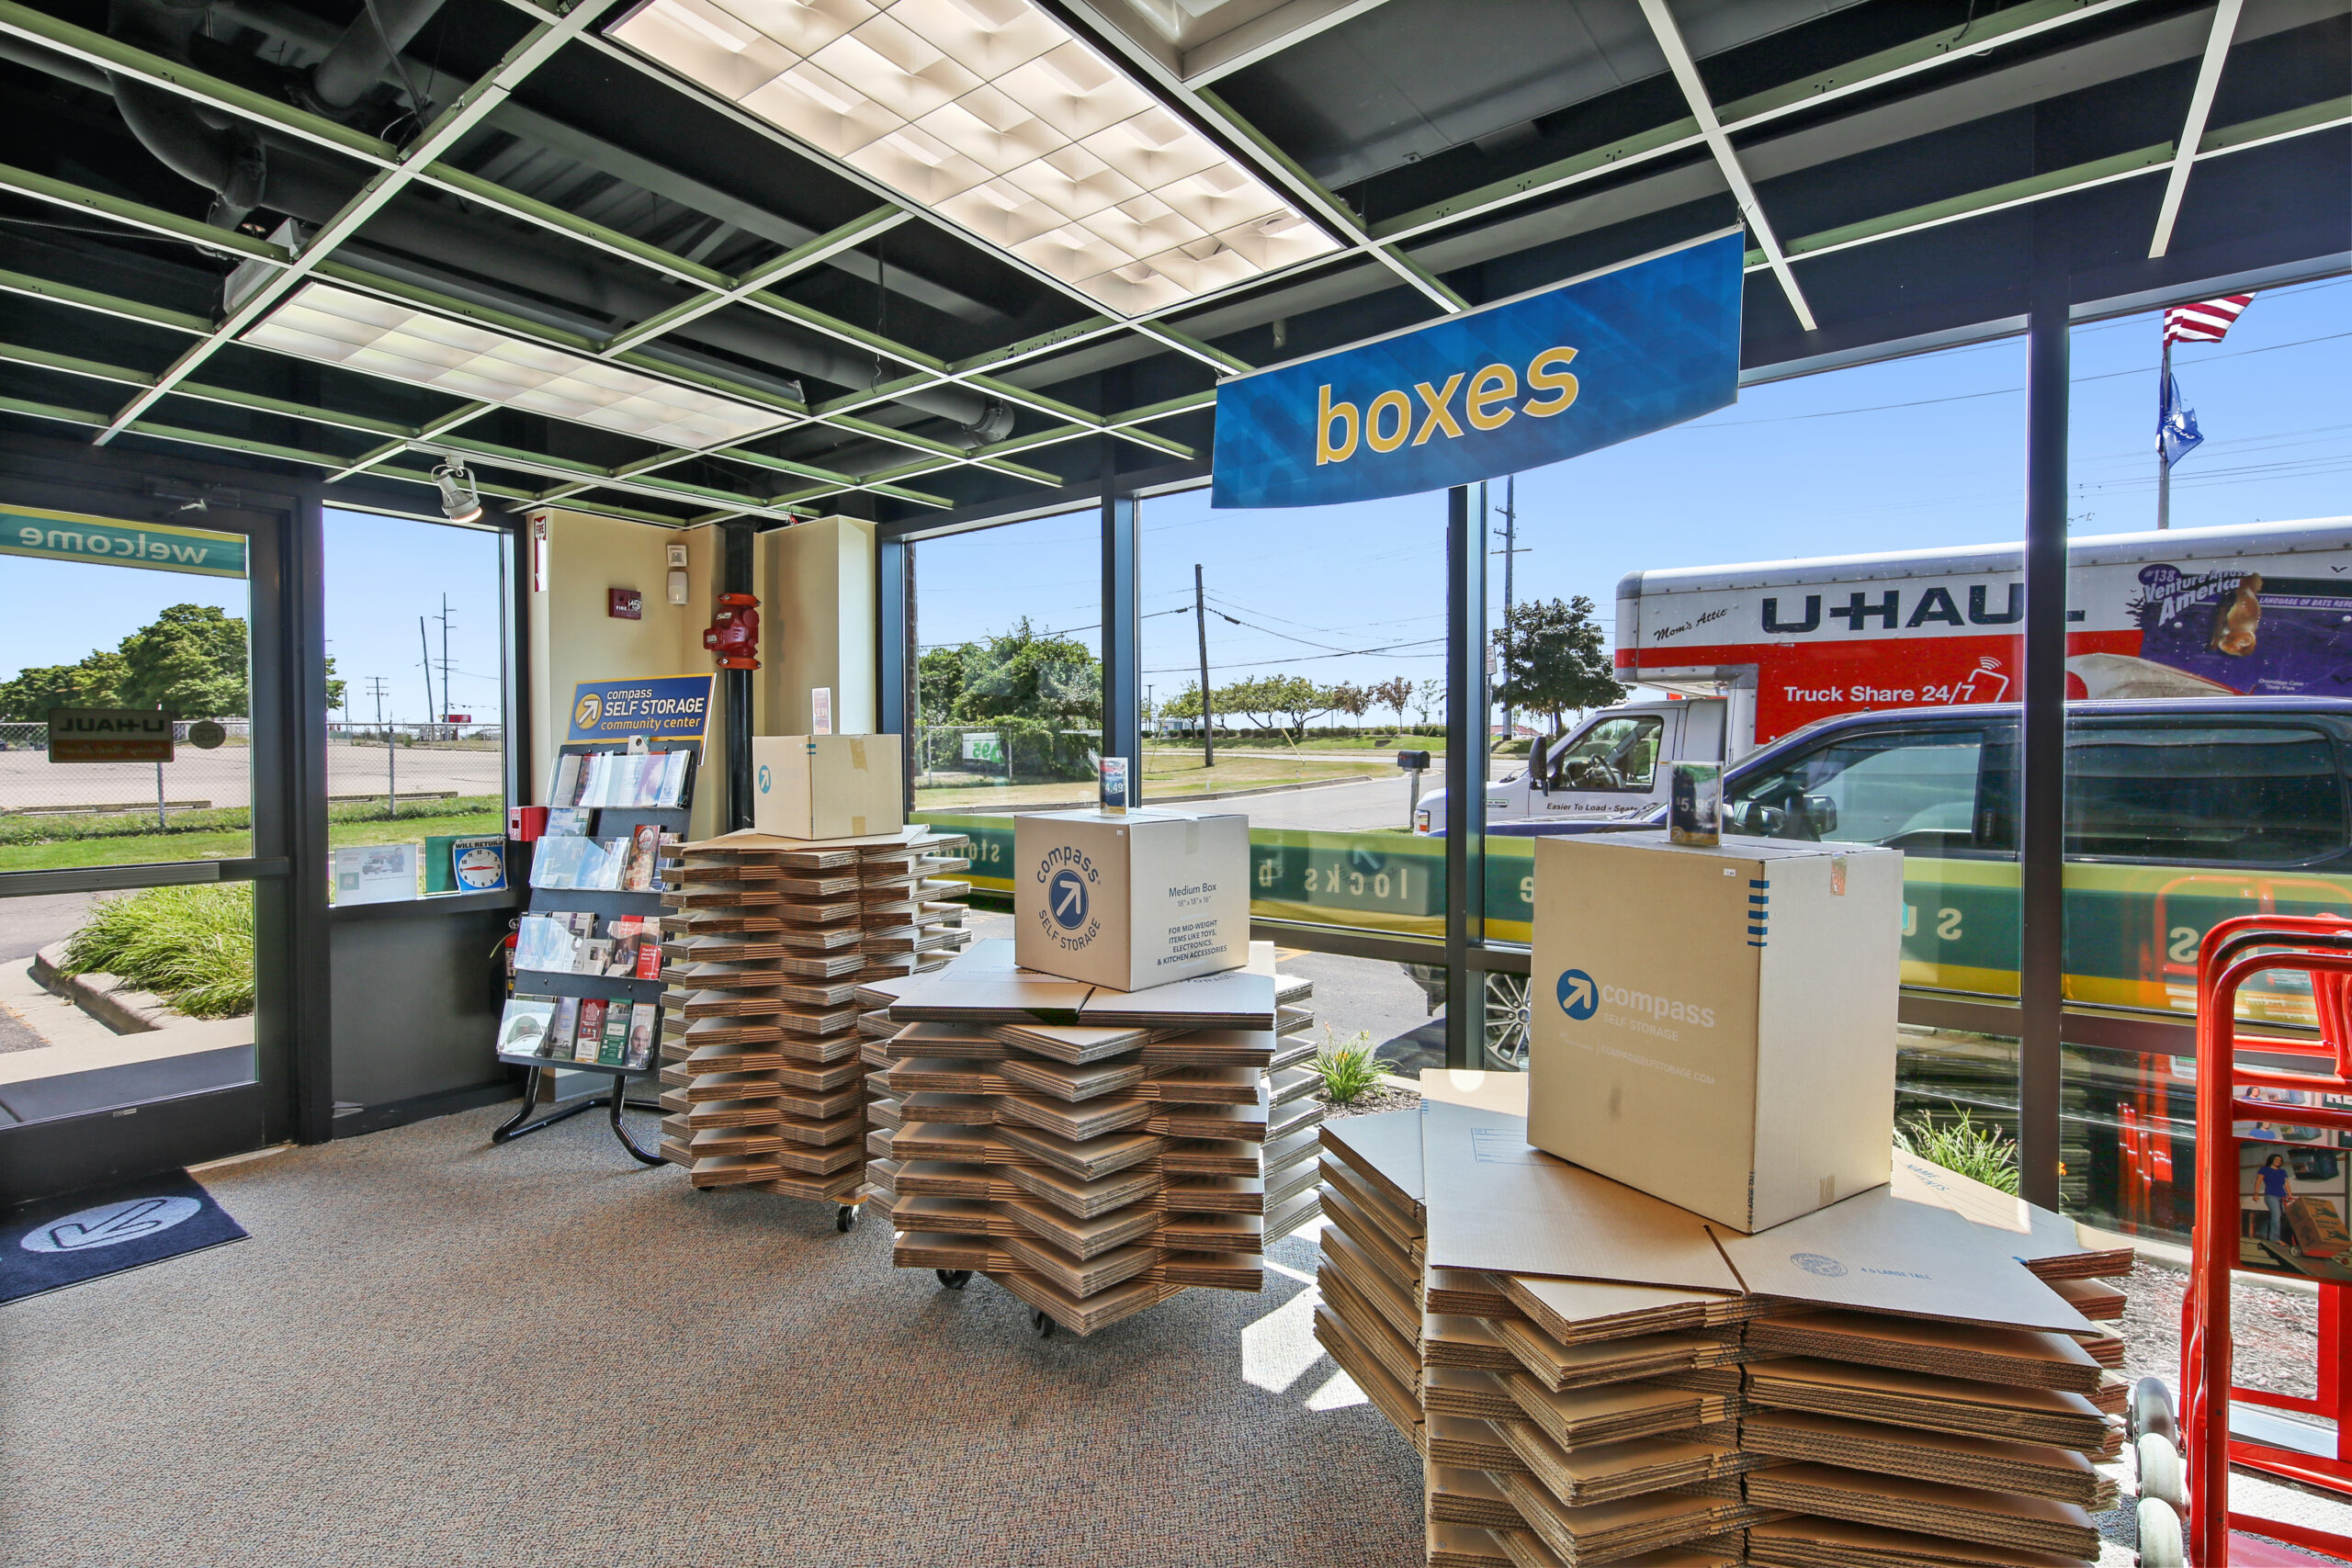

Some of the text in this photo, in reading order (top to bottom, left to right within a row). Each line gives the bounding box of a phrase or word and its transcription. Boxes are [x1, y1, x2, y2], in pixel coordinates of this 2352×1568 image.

[1316, 346, 1578, 466] boxes
[2144, 570, 2177, 581] #138
[2143, 574, 2206, 603] Venture
[2158, 578, 2242, 626] America
[2260, 597, 2298, 605] LANGUAGE
[1654, 608, 1727, 641] Mom's Attic
[606, 689, 652, 701] compass
[1784, 683, 1975, 705] Truck Share 24/7
[605, 697, 705, 716] SELF STORAGE
[601, 716, 701, 731] community center
[1546, 803, 1571, 811] Easier
[1586, 804, 1606, 812] Load
[1036, 845, 1100, 885] compass
[1169, 883, 1217, 897] Medium Box
[1039, 909, 1101, 952] SELF STORAGE
[1169, 919, 1217, 935] FOR MID-WEIGHT
[1169, 929, 1216, 944] ITEMS LIKE TOYS,
[1163, 953, 1189, 964] KITCHEN
[1190, 944, 1227, 960] ACCESSORIES
[1172, 940, 1213, 953] ELECTRONICS,
[1601, 984, 1715, 1029] compass
[1603, 1012, 1679, 1043] SELF STORAGE
